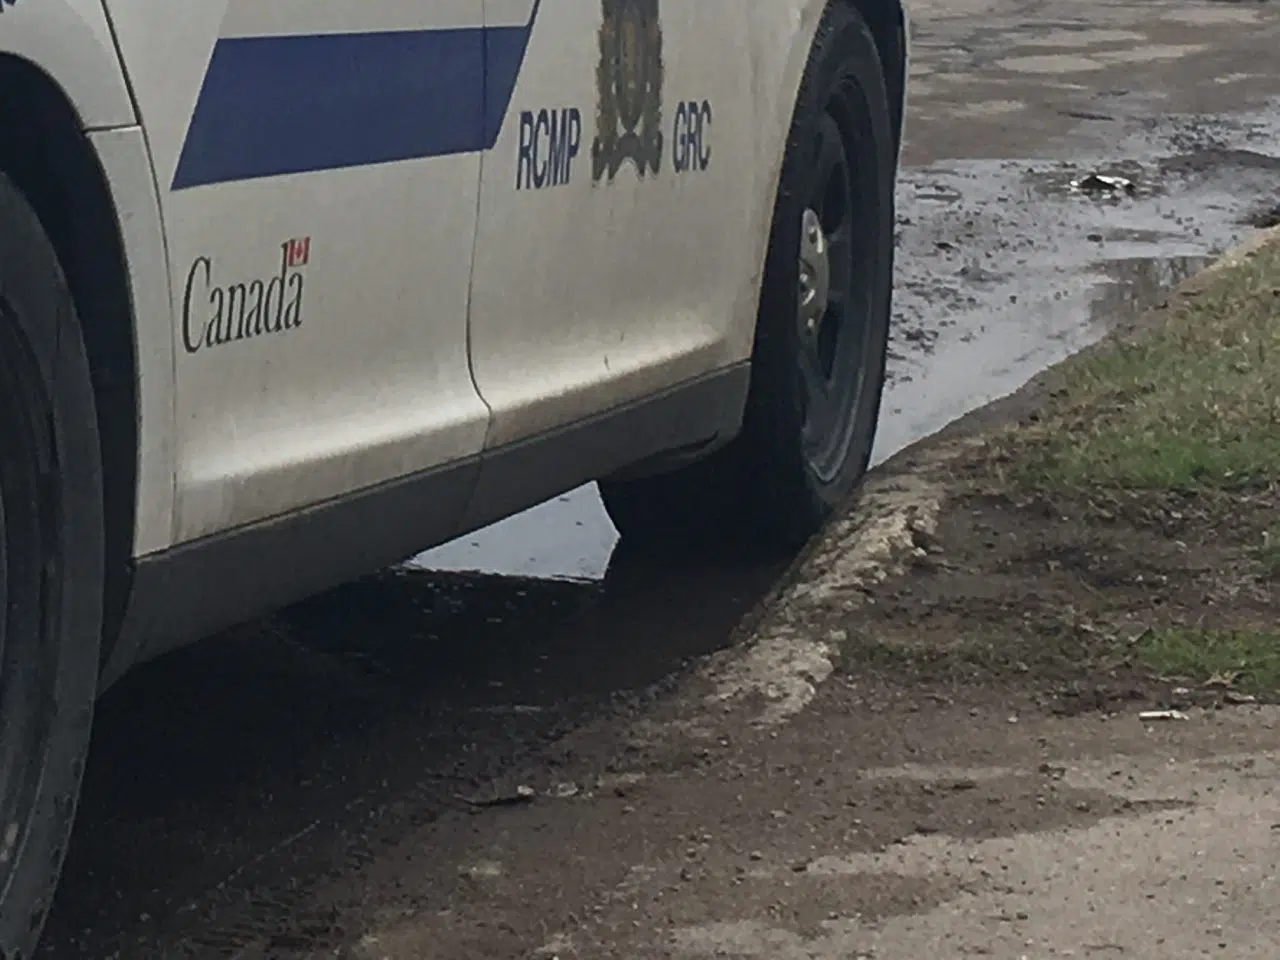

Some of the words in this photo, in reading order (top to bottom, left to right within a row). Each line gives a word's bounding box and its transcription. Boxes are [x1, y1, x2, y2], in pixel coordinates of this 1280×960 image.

[516, 107, 581, 190] RCMP
[673, 100, 712, 174] GRC
[182, 241, 304, 354] Canada
